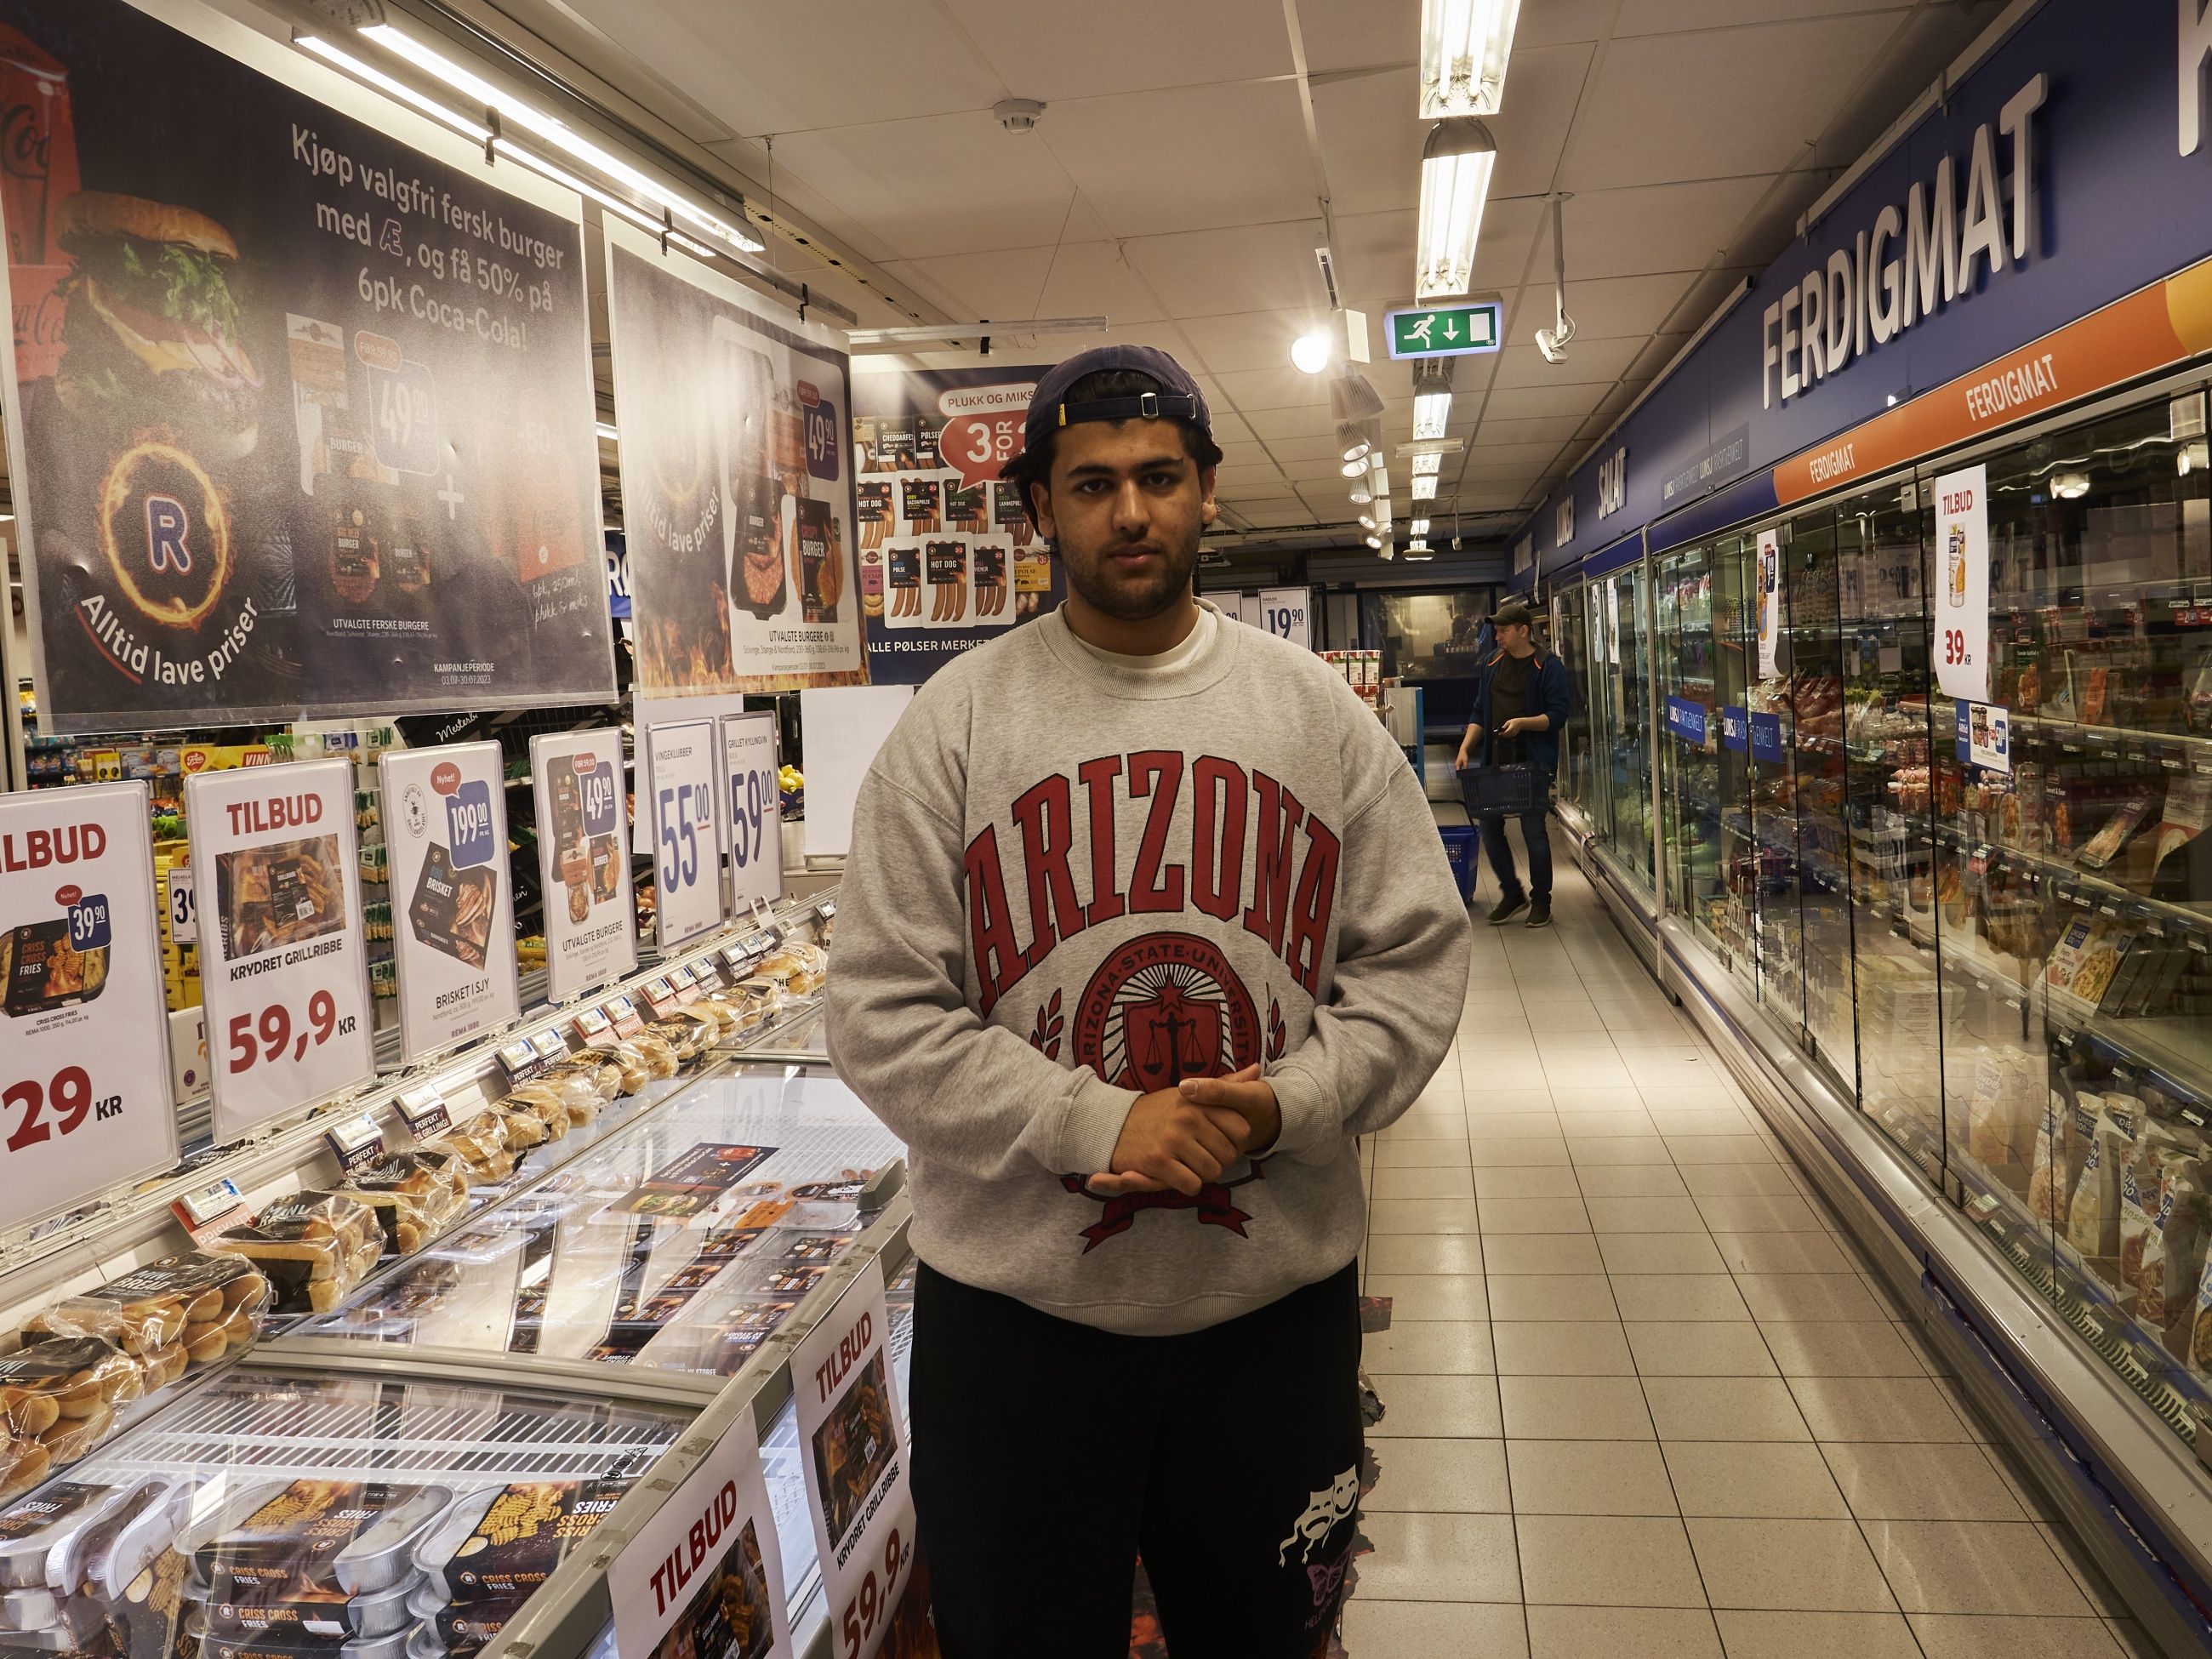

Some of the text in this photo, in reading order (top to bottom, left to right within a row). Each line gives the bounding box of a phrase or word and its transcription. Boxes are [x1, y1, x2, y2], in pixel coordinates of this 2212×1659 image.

[293, 123, 563, 270] Kjøp valgfri fersk burger
[1762, 73, 2046, 409] FERDIGMAT
[316, 202, 552, 312] med og få 50% på
[359, 267, 527, 351] 6pk Coca-Cola!
[948, 391, 1034, 408] PLUKK OG MIKS
[1966, 354, 2058, 422] FERDIGMAT
[382, 380, 412, 445] 49
[330, 437, 363, 455] BURGER
[809, 413, 834, 462] 49 90
[966, 420, 1013, 463] 3 FOR
[1810, 443, 1856, 484] FERDIGMAT
[1599, 447, 1626, 521] SALAT
[1942, 489, 1972, 516] TILBUD
[668, 486, 719, 553] lave priser
[749, 516, 764, 527] BURGER
[802, 539, 824, 557] BURGER
[333, 619, 430, 630] UTVALGTE FERSKE BURGERE
[769, 630, 824, 642] UTVALGTE BURGERE
[1268, 607, 1303, 639] 19 90
[81, 595, 258, 684] Alltid lave priser
[868, 641, 938, 653] ALLE PØLSER
[1945, 630, 1971, 666] 39 KR
[434, 662, 494, 673] KAMPANJEPERIODE
[655, 747, 692, 761] VINGEKLUBBER
[436, 772, 455, 784] Nyhet!
[586, 776, 612, 820] 49 90
[226, 793, 322, 835] TILBUD
[451, 804, 476, 846] 199
[477, 802, 487, 823] 00
[732, 769, 762, 869] 59
[761, 769, 772, 806] 00
[0, 823, 106, 874] LBUD
[659, 784, 698, 893] 55
[694, 783, 710, 823] 00
[593, 854, 608, 866] BURGER
[426, 877, 453, 898] BRISKET
[964, 750, 1342, 1020] ARIZONA
[73, 905, 105, 941] 39 90
[562, 931, 595, 951] UTVALGTE
[596, 921, 623, 940] BURGERE
[20, 952, 46, 965] CROSS
[21, 941, 45, 954] CRISS
[231, 938, 342, 981] KRYDRET GRILLRIBBE
[1120, 944, 1185, 971] STATE
[20, 963, 42, 976] FRIES
[436, 985, 470, 1009] BRISKET
[476, 978, 489, 994] SJY
[37, 1011, 77, 1025] CRISS CROSS FRIES
[229, 989, 356, 1074] 59,9 KR
[451, 1021, 479, 1038] REMA 1000
[26, 1028, 39, 1036] REMA
[544, 1052, 563, 1066] PERFEKT
[513, 1065, 533, 1081] PERFEKT
[2, 1065, 123, 1152] 29 KR
[414, 1113, 439, 1130] PERFEKT
[413, 1119, 449, 1142] TIL GRILLING!
[348, 1145, 374, 1166] PERFEKT
[816, 1311, 872, 1405] TILBUD
[334, 1509, 378, 1519] FRIES
[573, 1501, 619, 1514] FRIES
[837, 1461, 900, 1571] KRYDRET GRILLRIBBE
[304, 1528, 351, 1537] CRISS
[650, 1480, 737, 1617] TILBUD
[229, 1566, 288, 1579] CRISS CROSS
[234, 1576, 260, 1585] FRIES
[482, 1573, 547, 1583] CRISS CROSS
[487, 1582, 516, 1591] FRIES
[843, 1528, 909, 1657] 59,9 KR
[238, 1608, 298, 1622] CRISS CROSS
[242, 1620, 269, 1628] FRIES
